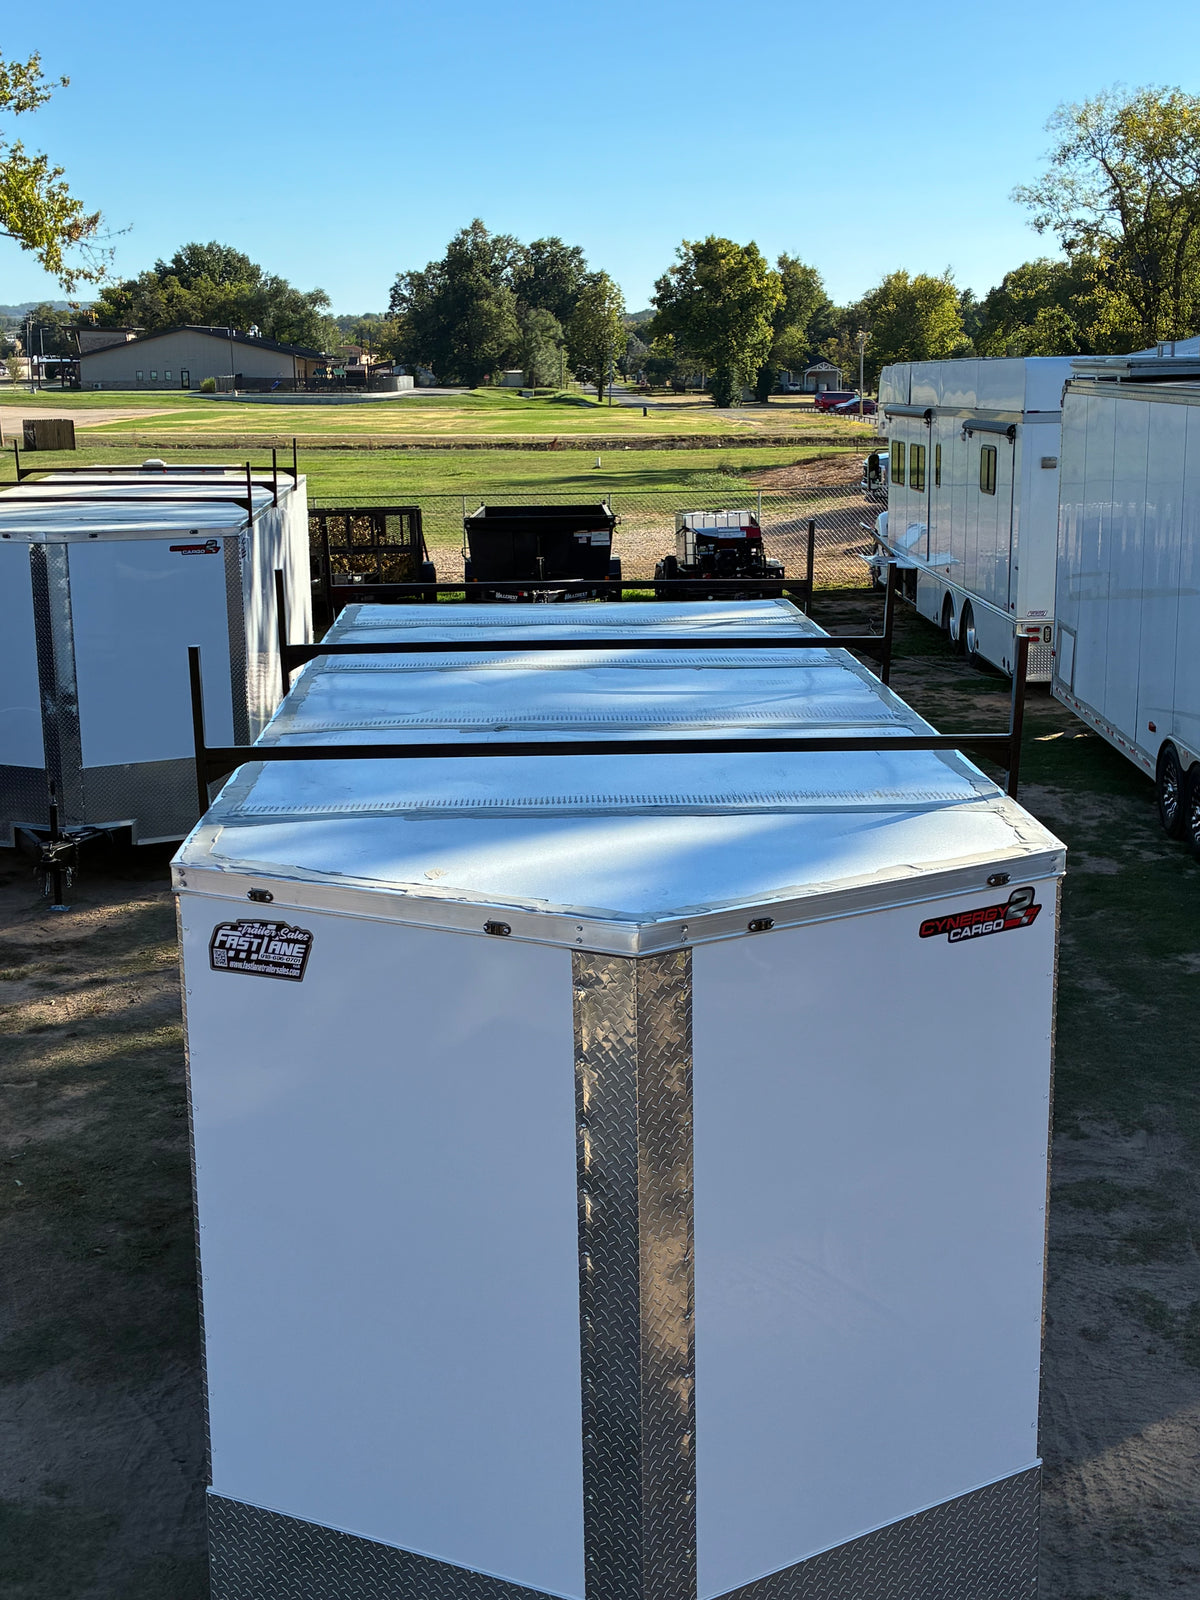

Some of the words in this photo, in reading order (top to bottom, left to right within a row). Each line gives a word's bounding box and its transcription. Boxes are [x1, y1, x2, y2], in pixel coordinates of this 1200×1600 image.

[921, 905, 1010, 935] CYNERGY
[950, 918, 1005, 940] CARGO
[240, 923, 277, 937] Trailer
[279, 927, 310, 941] Sales
